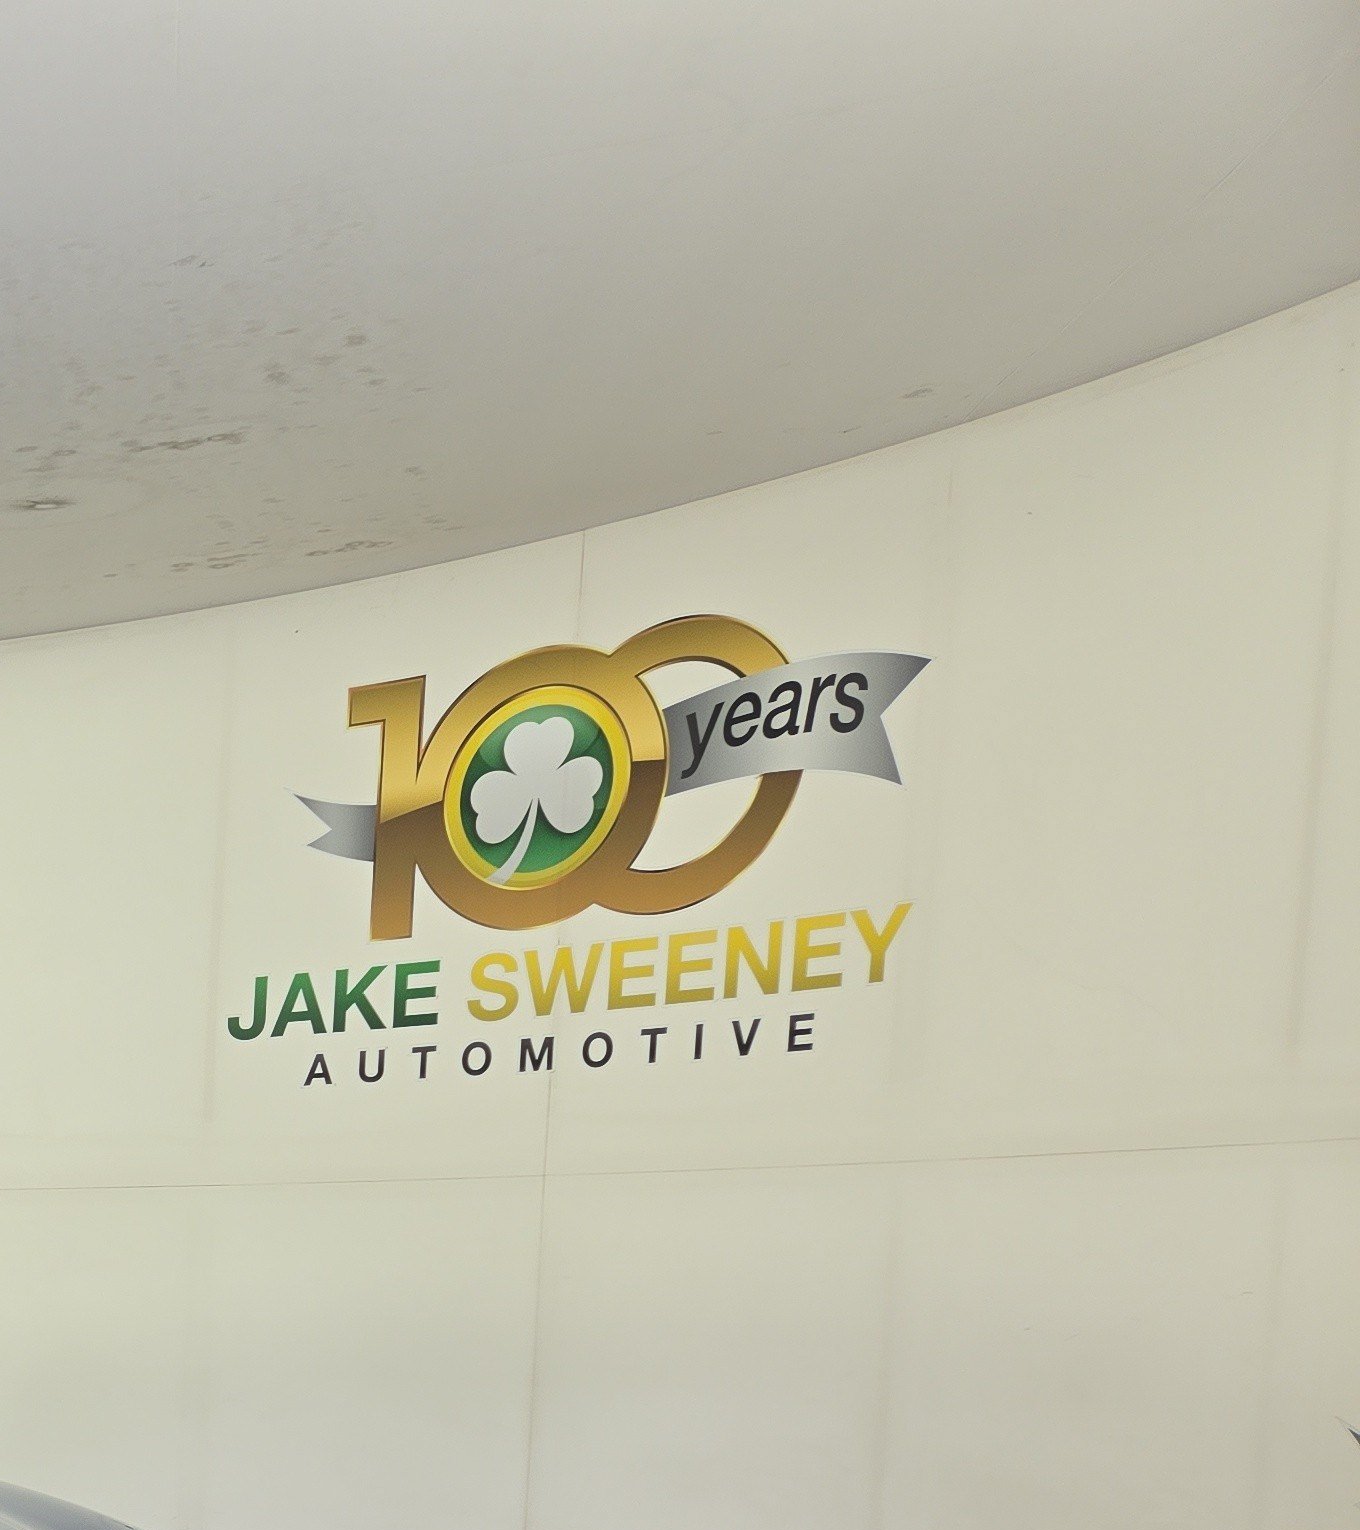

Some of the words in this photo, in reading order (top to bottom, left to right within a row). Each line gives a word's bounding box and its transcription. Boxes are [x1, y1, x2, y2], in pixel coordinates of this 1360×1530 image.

[680, 671, 870, 779] years
[226, 958, 442, 1041] JAKE
[466, 902, 914, 1022] SWEENEY
[304, 1012, 816, 1087] AUTOMOTIVE
